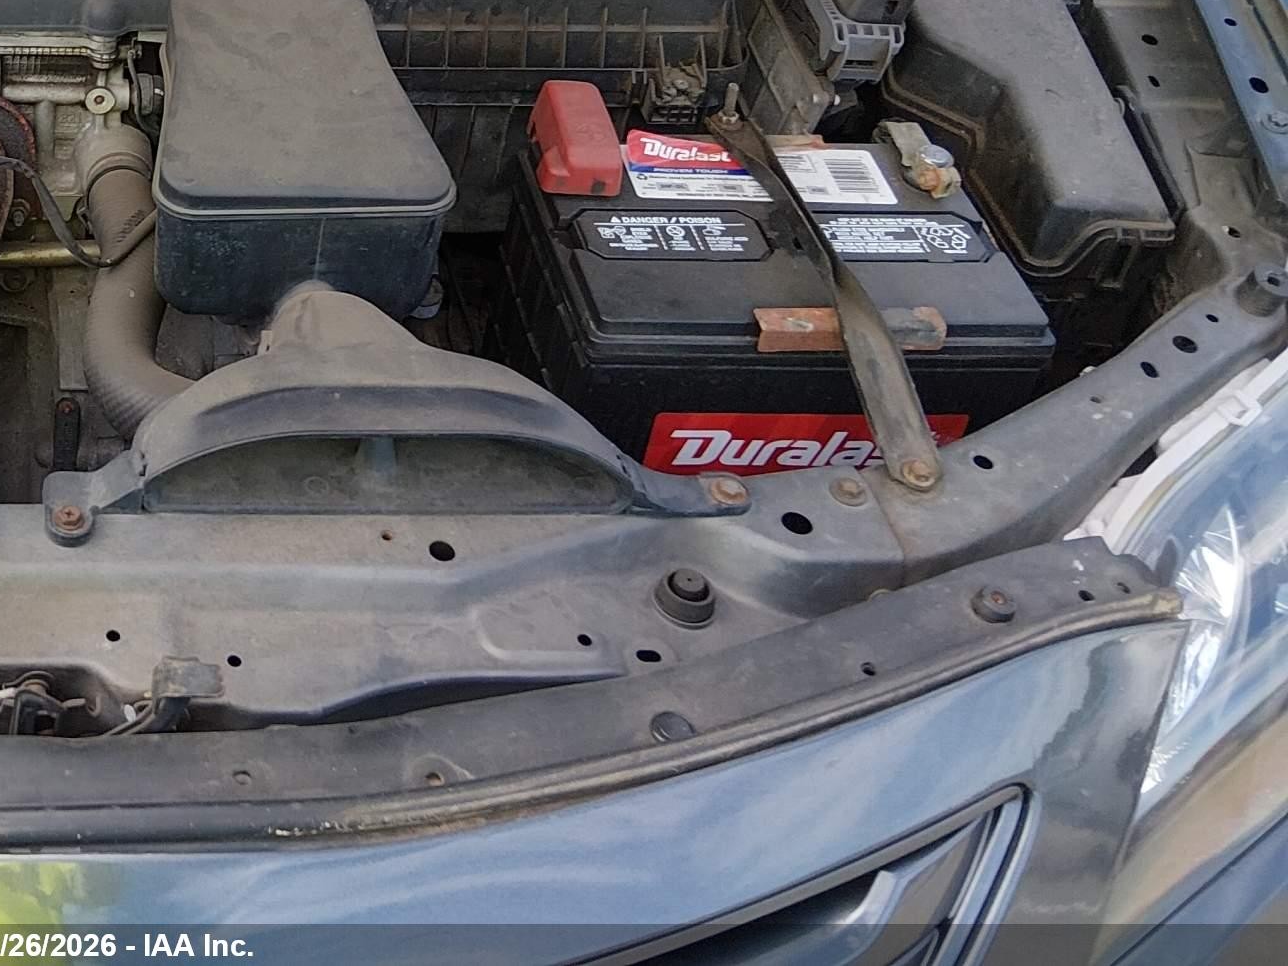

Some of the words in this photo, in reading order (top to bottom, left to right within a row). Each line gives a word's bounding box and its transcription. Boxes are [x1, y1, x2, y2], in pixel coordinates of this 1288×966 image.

[639, 137, 732, 162] Duralast
[621, 216, 669, 224] DANGER
[678, 216, 722, 224] POISON
[669, 429, 885, 466] Durala
